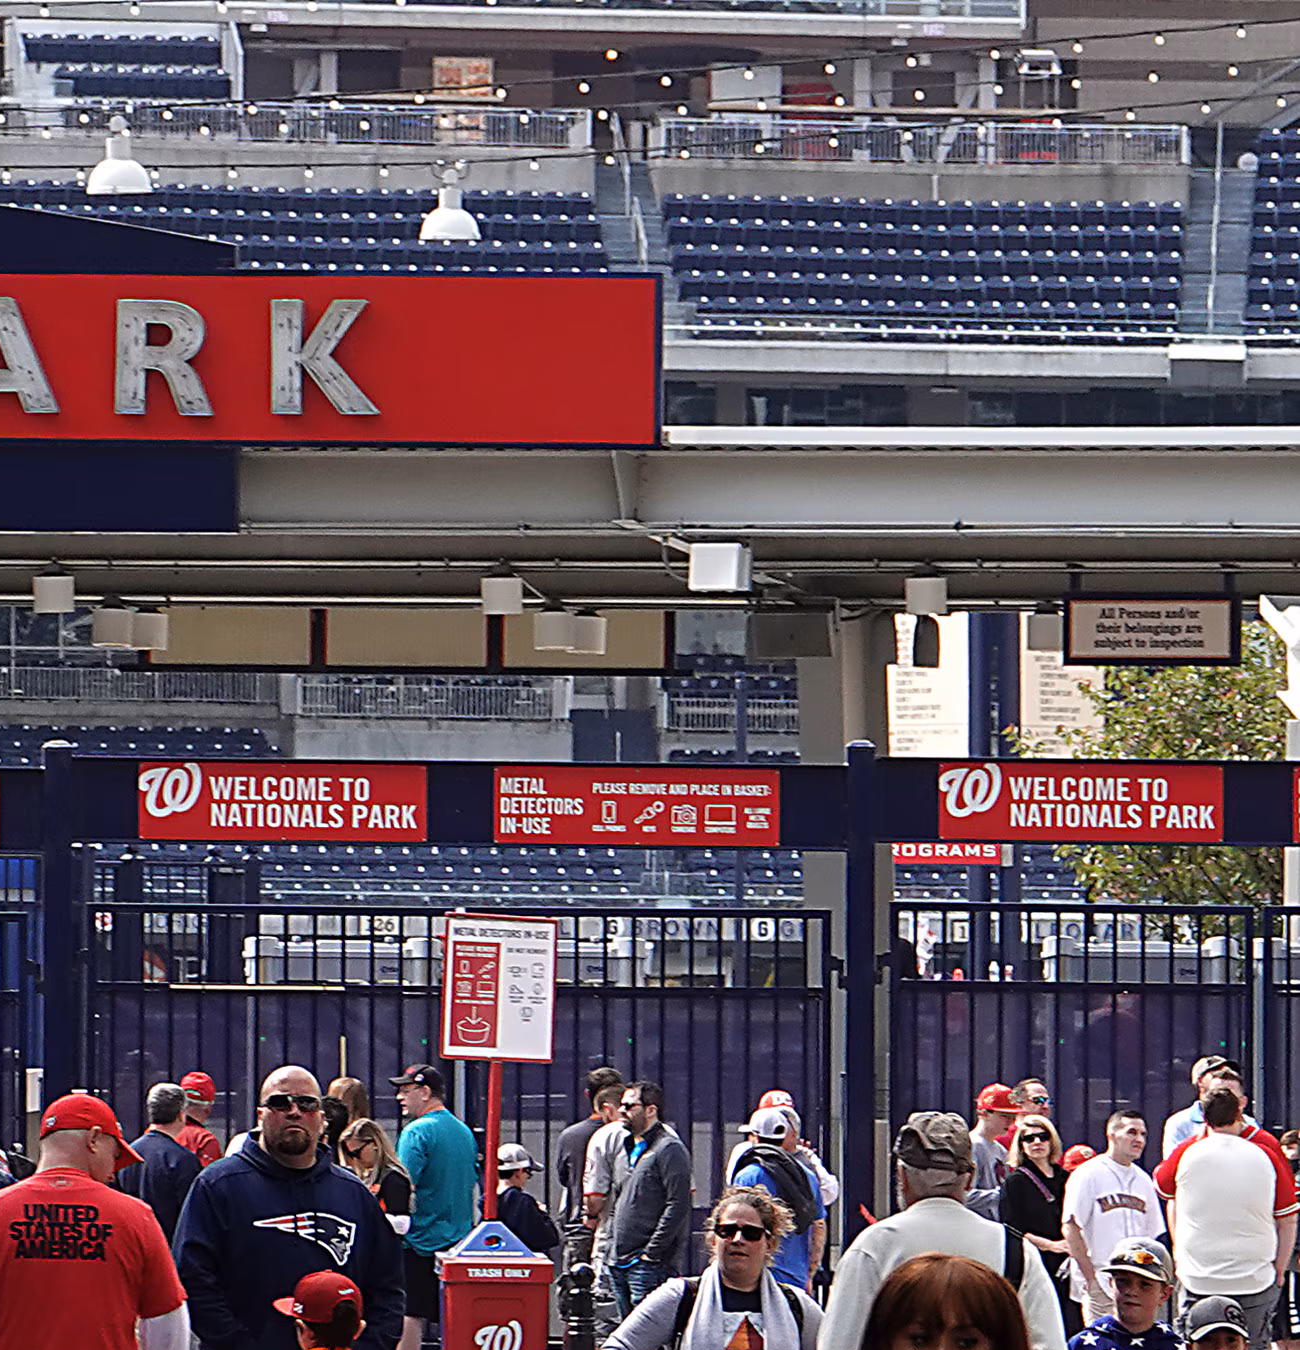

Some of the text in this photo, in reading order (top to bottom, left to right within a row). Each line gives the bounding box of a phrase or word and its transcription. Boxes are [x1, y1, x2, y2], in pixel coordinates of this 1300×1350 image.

[1098, 606, 1201, 619] All Persons and/or
[1096, 622, 1203, 636] their belongings are
[1094, 636, 1205, 650] subject to inspection
[209, 776, 371, 802] WELCOME TO
[500, 777, 548, 795] METAL
[592, 782, 628, 795] PLEASE
[629, 783, 668, 796] REMOVE
[668, 784, 688, 796] AND
[690, 784, 720, 796] PLACE
[721, 784, 733, 796] IN
[1008, 776, 1169, 803] WELCOME TO
[500, 797, 584, 815] DETECTORS
[210, 803, 418, 830] NATIONALS PARK
[500, 817, 552, 834] IN-USE
[1009, 803, 1216, 830] NATIONALS PARK
[453, 927, 551, 940] METAL DETECTORS IN-USE
[23, 1203, 99, 1222] UNITED
[9, 1221, 113, 1242] STATES OF
[14, 1240, 106, 1261] AMERICA
[466, 1268, 532, 1278] TRASH ONLY
